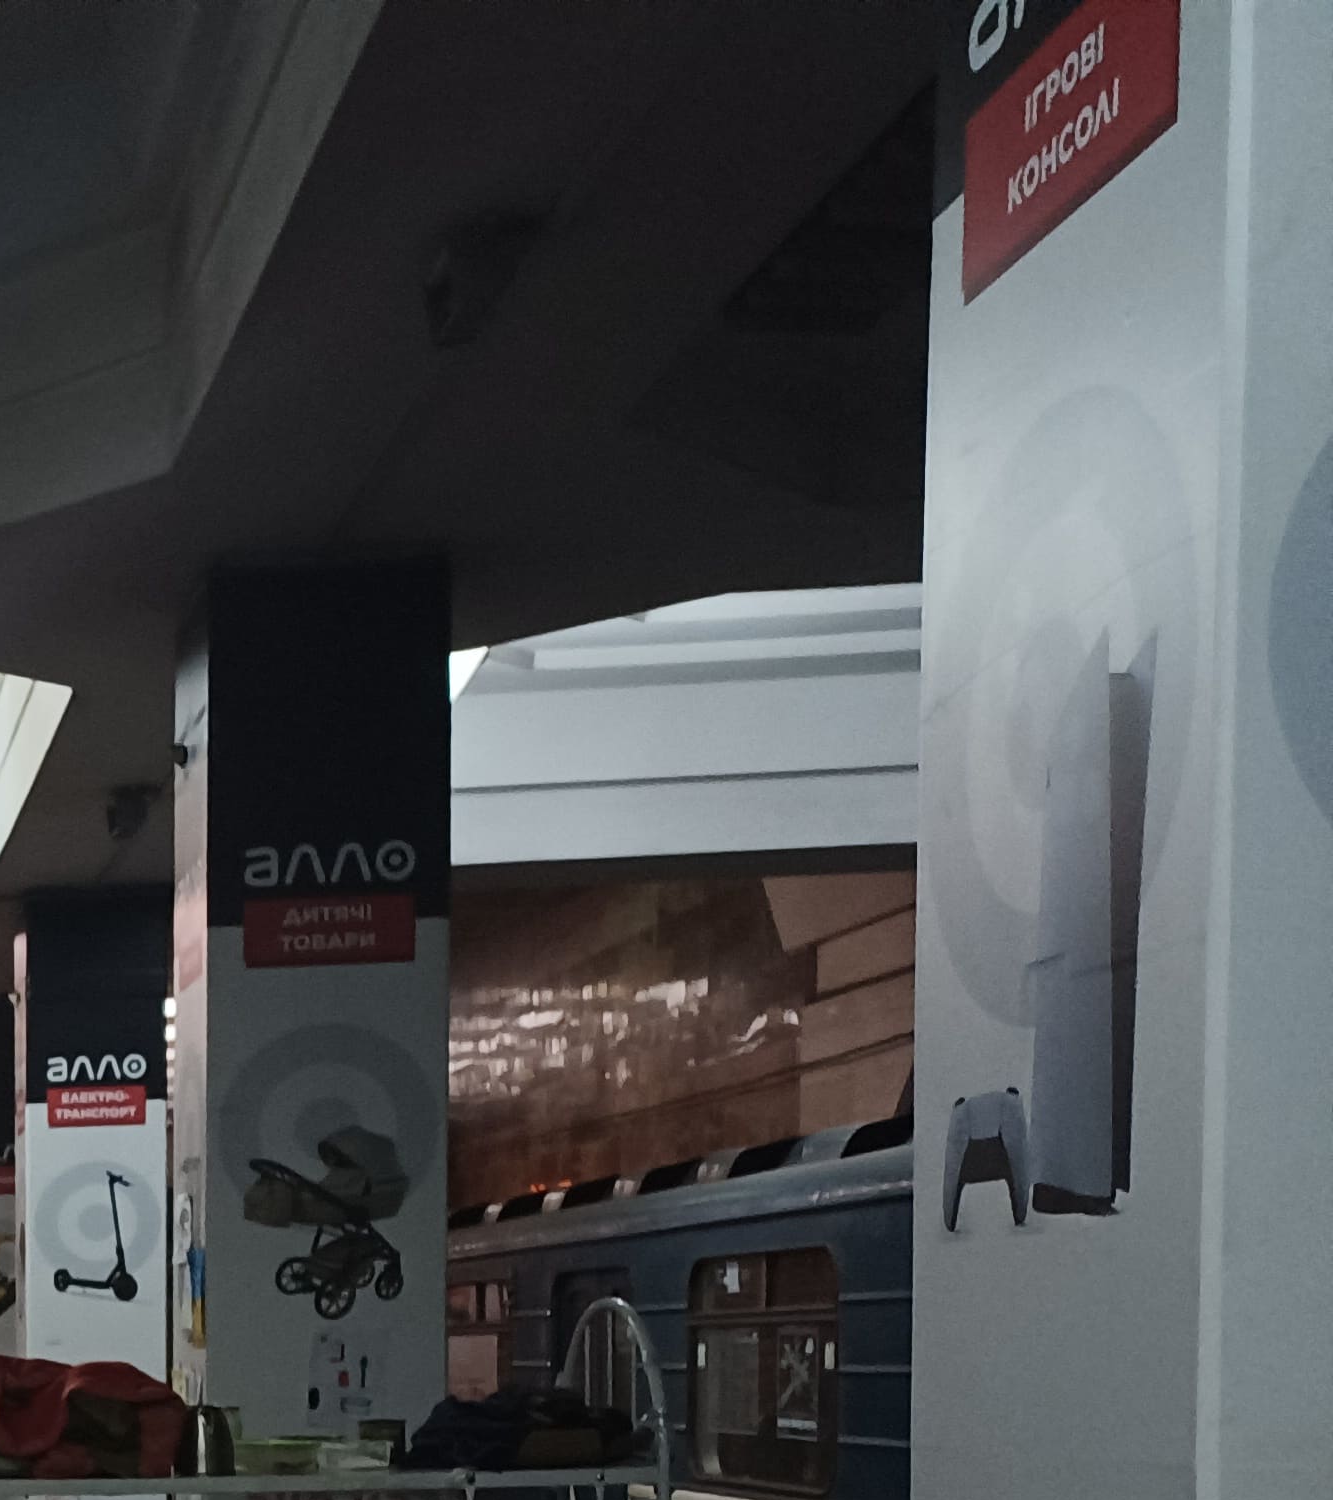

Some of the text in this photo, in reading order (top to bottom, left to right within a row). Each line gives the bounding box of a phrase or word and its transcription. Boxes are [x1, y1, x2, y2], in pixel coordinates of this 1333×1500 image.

[1024, 21, 1105, 134] ІГРОВІ
[1007, 77, 1120, 215] КОНСОЛІ
[244, 839, 416, 887] алло
[282, 903, 372, 928] ДИТЯЧІ
[280, 931, 376, 953] ТОВАРИ
[47, 1052, 147, 1083] алло
[61, 1090, 130, 1104] ЕЛЕКТРО-
[54, 1105, 137, 1120] ТРАНСПОРТ
